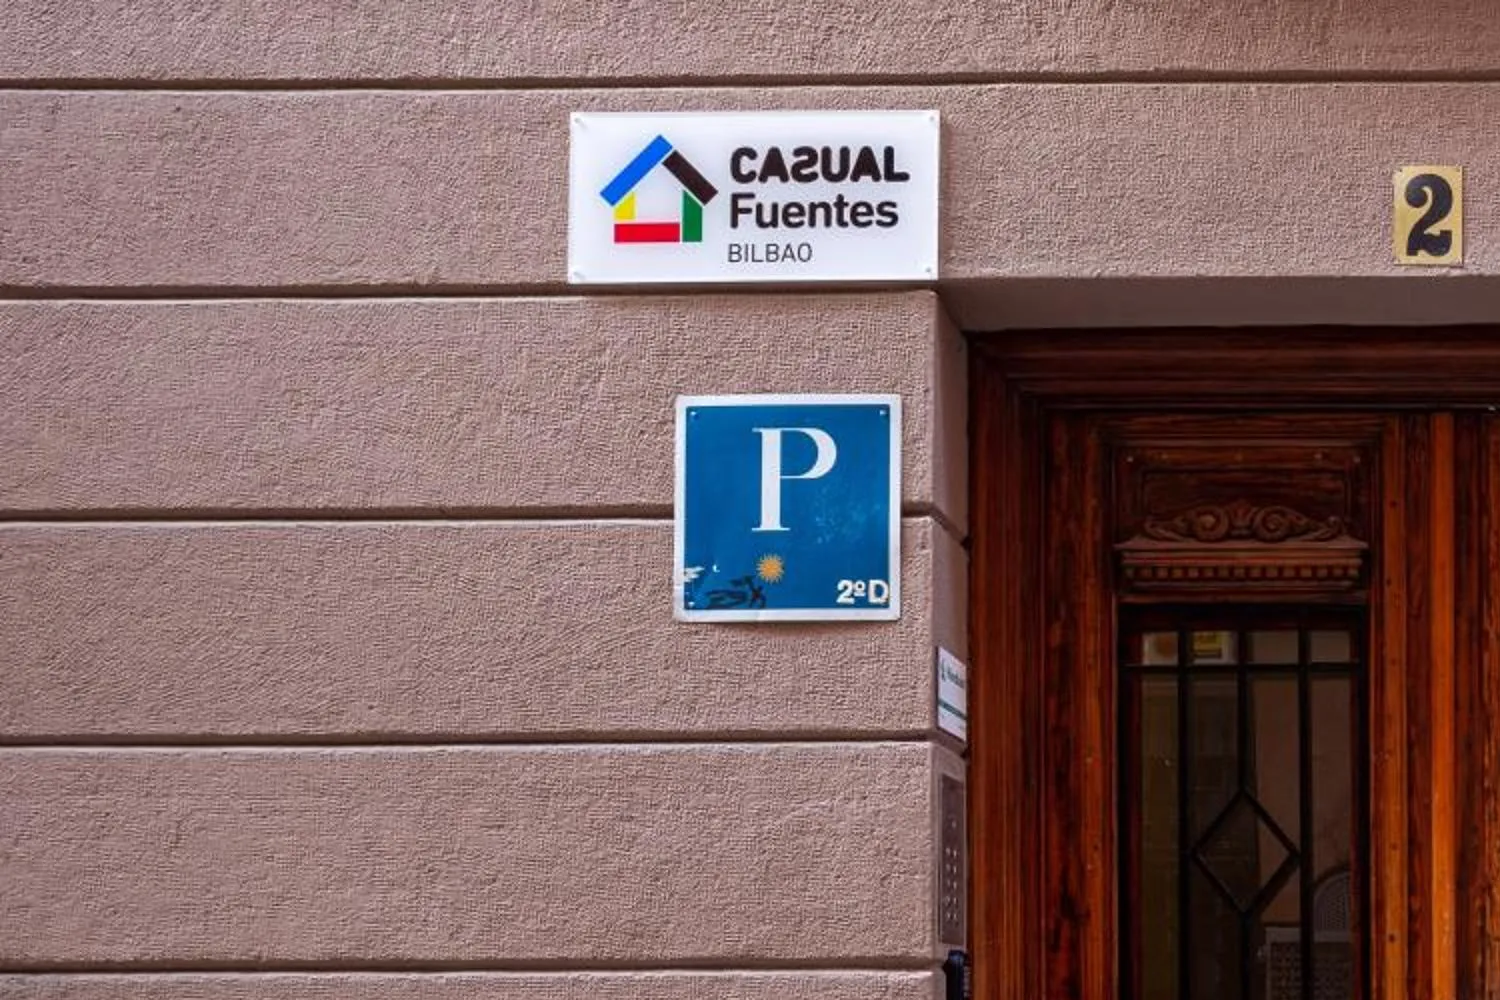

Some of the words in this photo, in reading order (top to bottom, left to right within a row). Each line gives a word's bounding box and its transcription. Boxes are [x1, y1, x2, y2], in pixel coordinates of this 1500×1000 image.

[729, 145, 910, 184] CASUAL
[729, 193, 900, 230] Fuentes
[1404, 173, 1453, 256] 2
[727, 243, 814, 264] BILBAO
[751, 427, 837, 532] P
